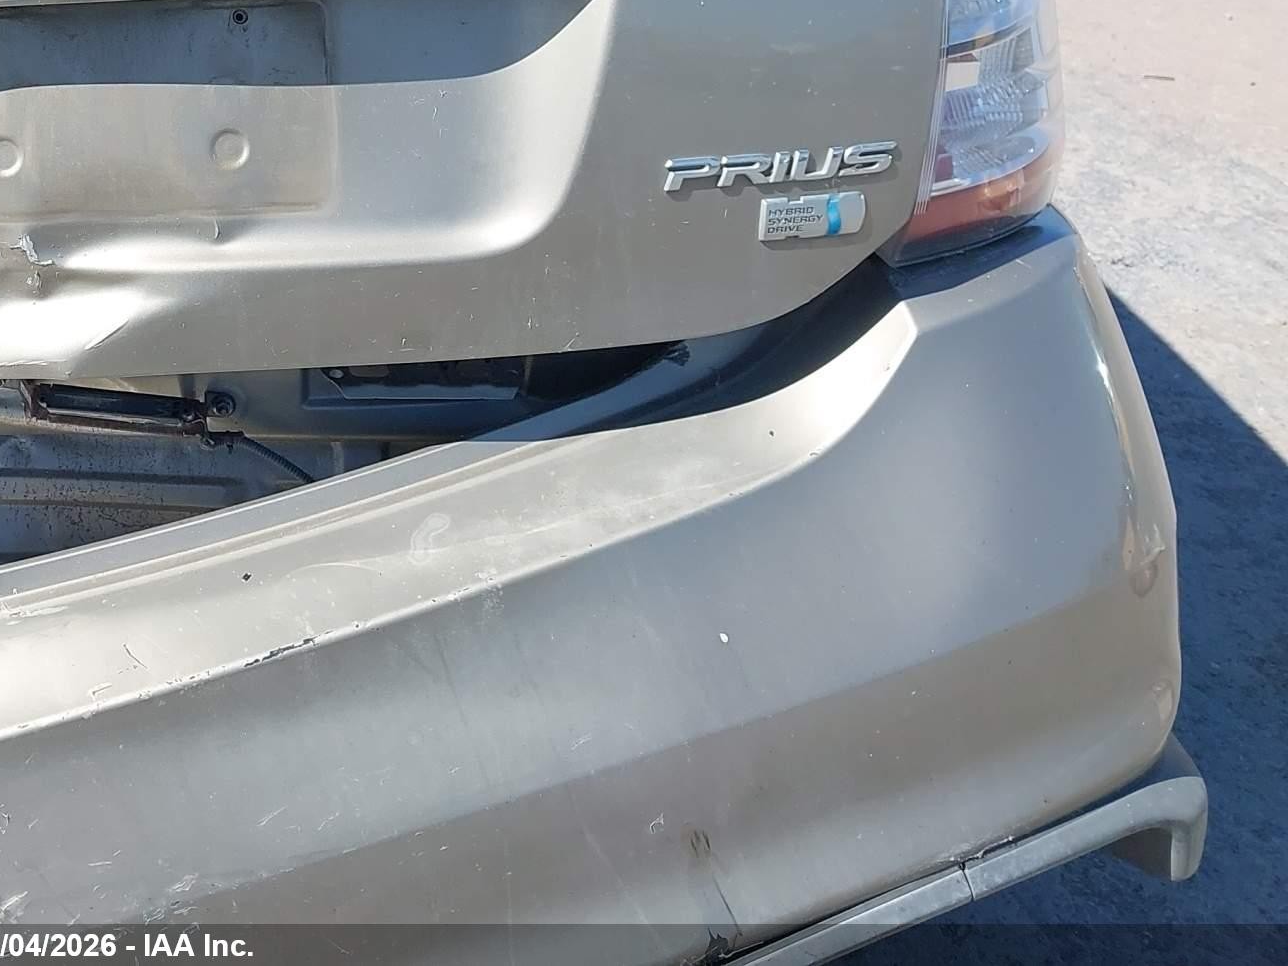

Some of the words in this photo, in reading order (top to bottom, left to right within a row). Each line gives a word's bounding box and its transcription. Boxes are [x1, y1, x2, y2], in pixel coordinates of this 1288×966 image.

[663, 140, 898, 193] PRIUS
[768, 206, 815, 217] HYBRID
[767, 214, 823, 226] SYNERGY
[767, 224, 804, 234] DRIVE
